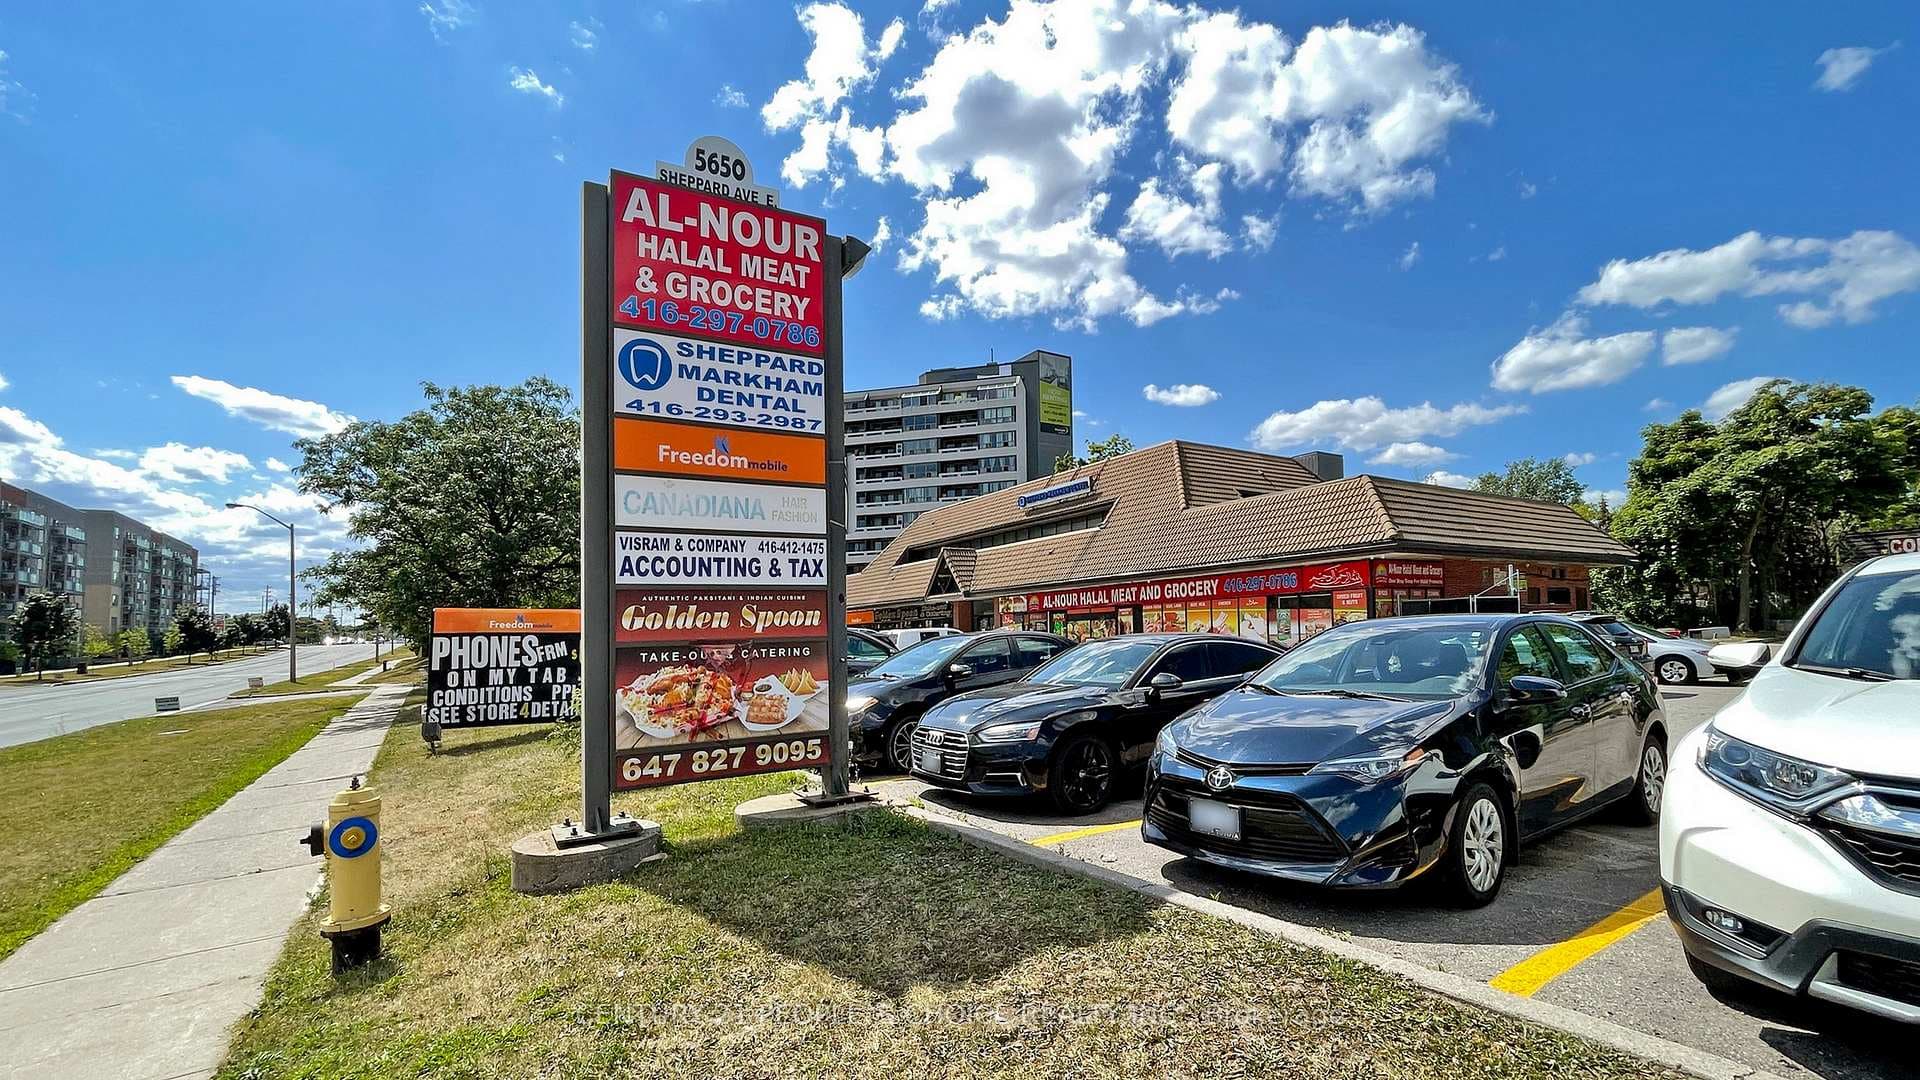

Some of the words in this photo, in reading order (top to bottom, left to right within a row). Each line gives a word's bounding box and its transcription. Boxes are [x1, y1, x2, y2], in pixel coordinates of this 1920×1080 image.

[694, 148, 746, 181] 5650
[659, 169, 730, 197] SHEPPARD
[622, 187, 821, 262] AL-NOUR
[637, 232, 732, 274] HALAL
[741, 253, 811, 288] MEAT
[635, 266, 658, 294] &
[665, 272, 811, 321] GROCERY
[619, 295, 820, 346] 416-297-0786
[676, 342, 824, 376] SHEPPARD
[678, 364, 823, 396] MARKHAM
[697, 386, 806, 413] DENTAL
[625, 399, 822, 431] 416-293-2987
[658, 444, 748, 469] Freedom
[748, 460, 788, 472] mobile
[624, 489, 766, 521] CANADIANA
[772, 511, 818, 523] FASHION
[782, 496, 807, 509] HAIR
[620, 536, 670, 551] VISRAM
[674, 538, 684, 551] &
[688, 539, 746, 553] COMPANY
[758, 541, 824, 555] 416-412-1475
[620, 556, 761, 578] ACCOUNTING
[768, 558, 782, 577] &
[788, 558, 824, 578] TAX
[1043, 594, 1078, 609] AL-NOUR
[1080, 590, 1109, 605] HALAL
[1111, 586, 1138, 603] MEAT
[1140, 584, 1161, 600] AND
[1164, 579, 1219, 598] GROCERY
[489, 621, 533, 629] Freedom
[621, 604, 730, 631] Golden
[740, 604, 821, 633] Spoon
[432, 635, 539, 671] PHONES
[536, 641, 568, 662] FRM
[741, 647, 811, 659] CATERING
[447, 670, 476, 687] ON
[488, 669, 517, 686] MY
[528, 667, 566, 684] TAB
[433, 685, 533, 707] CONDITIONS
[429, 706, 461, 724] SEE
[466, 702, 518, 722] STORE
[519, 702, 529, 719] 4
[621, 754, 681, 781] 647
[692, 747, 746, 774] 827
[756, 739, 822, 765] 9095
